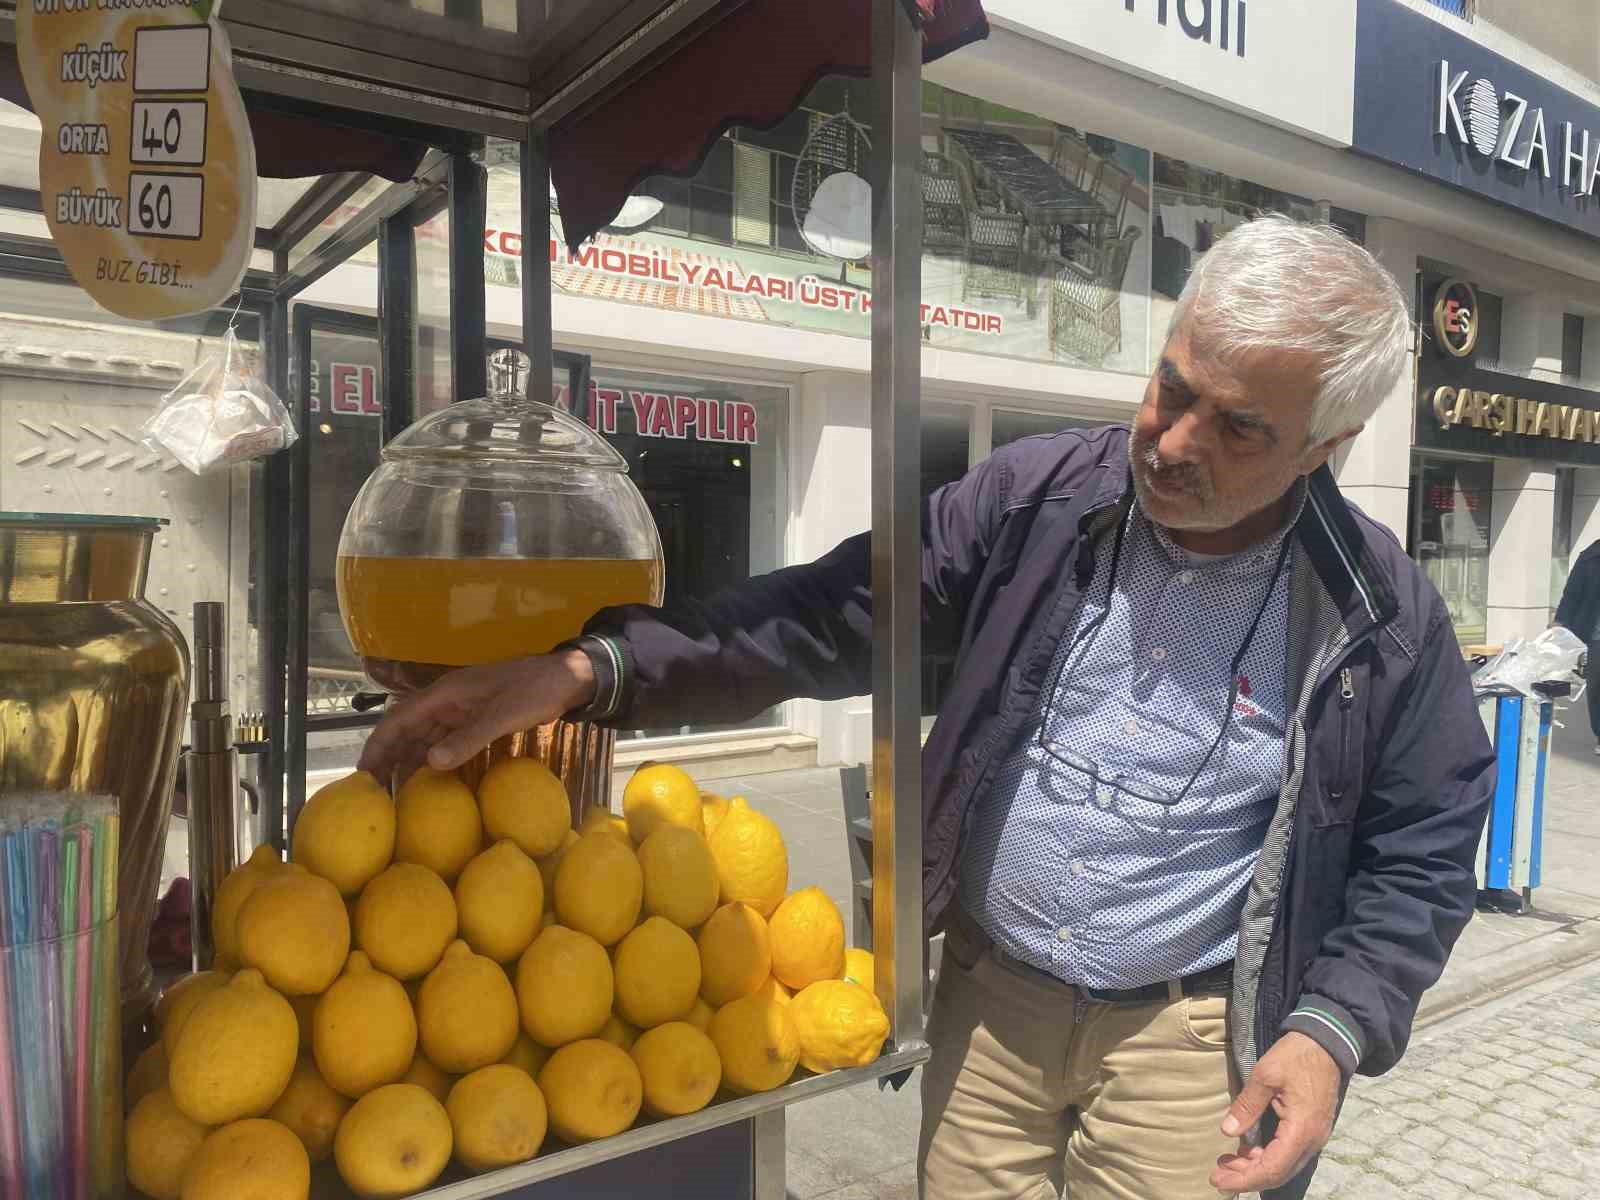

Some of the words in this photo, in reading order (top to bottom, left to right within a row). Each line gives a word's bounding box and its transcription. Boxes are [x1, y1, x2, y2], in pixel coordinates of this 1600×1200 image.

[61, 43, 128, 87] KÜÇÜK
[57, 123, 110, 154] ORTA
[141, 108, 181, 157] 40
[1436, 58, 1551, 178] KOZA
[55, 188, 122, 228] BÜYÜK
[138, 182, 172, 229] 60
[95, 257, 130, 282] BUZ
[567, 246, 793, 301] MOBİLYALARI
[801, 277, 856, 311] ÜST
[629, 390, 758, 445] YAPILIR
[1433, 385, 1514, 437] ÇARŞI
